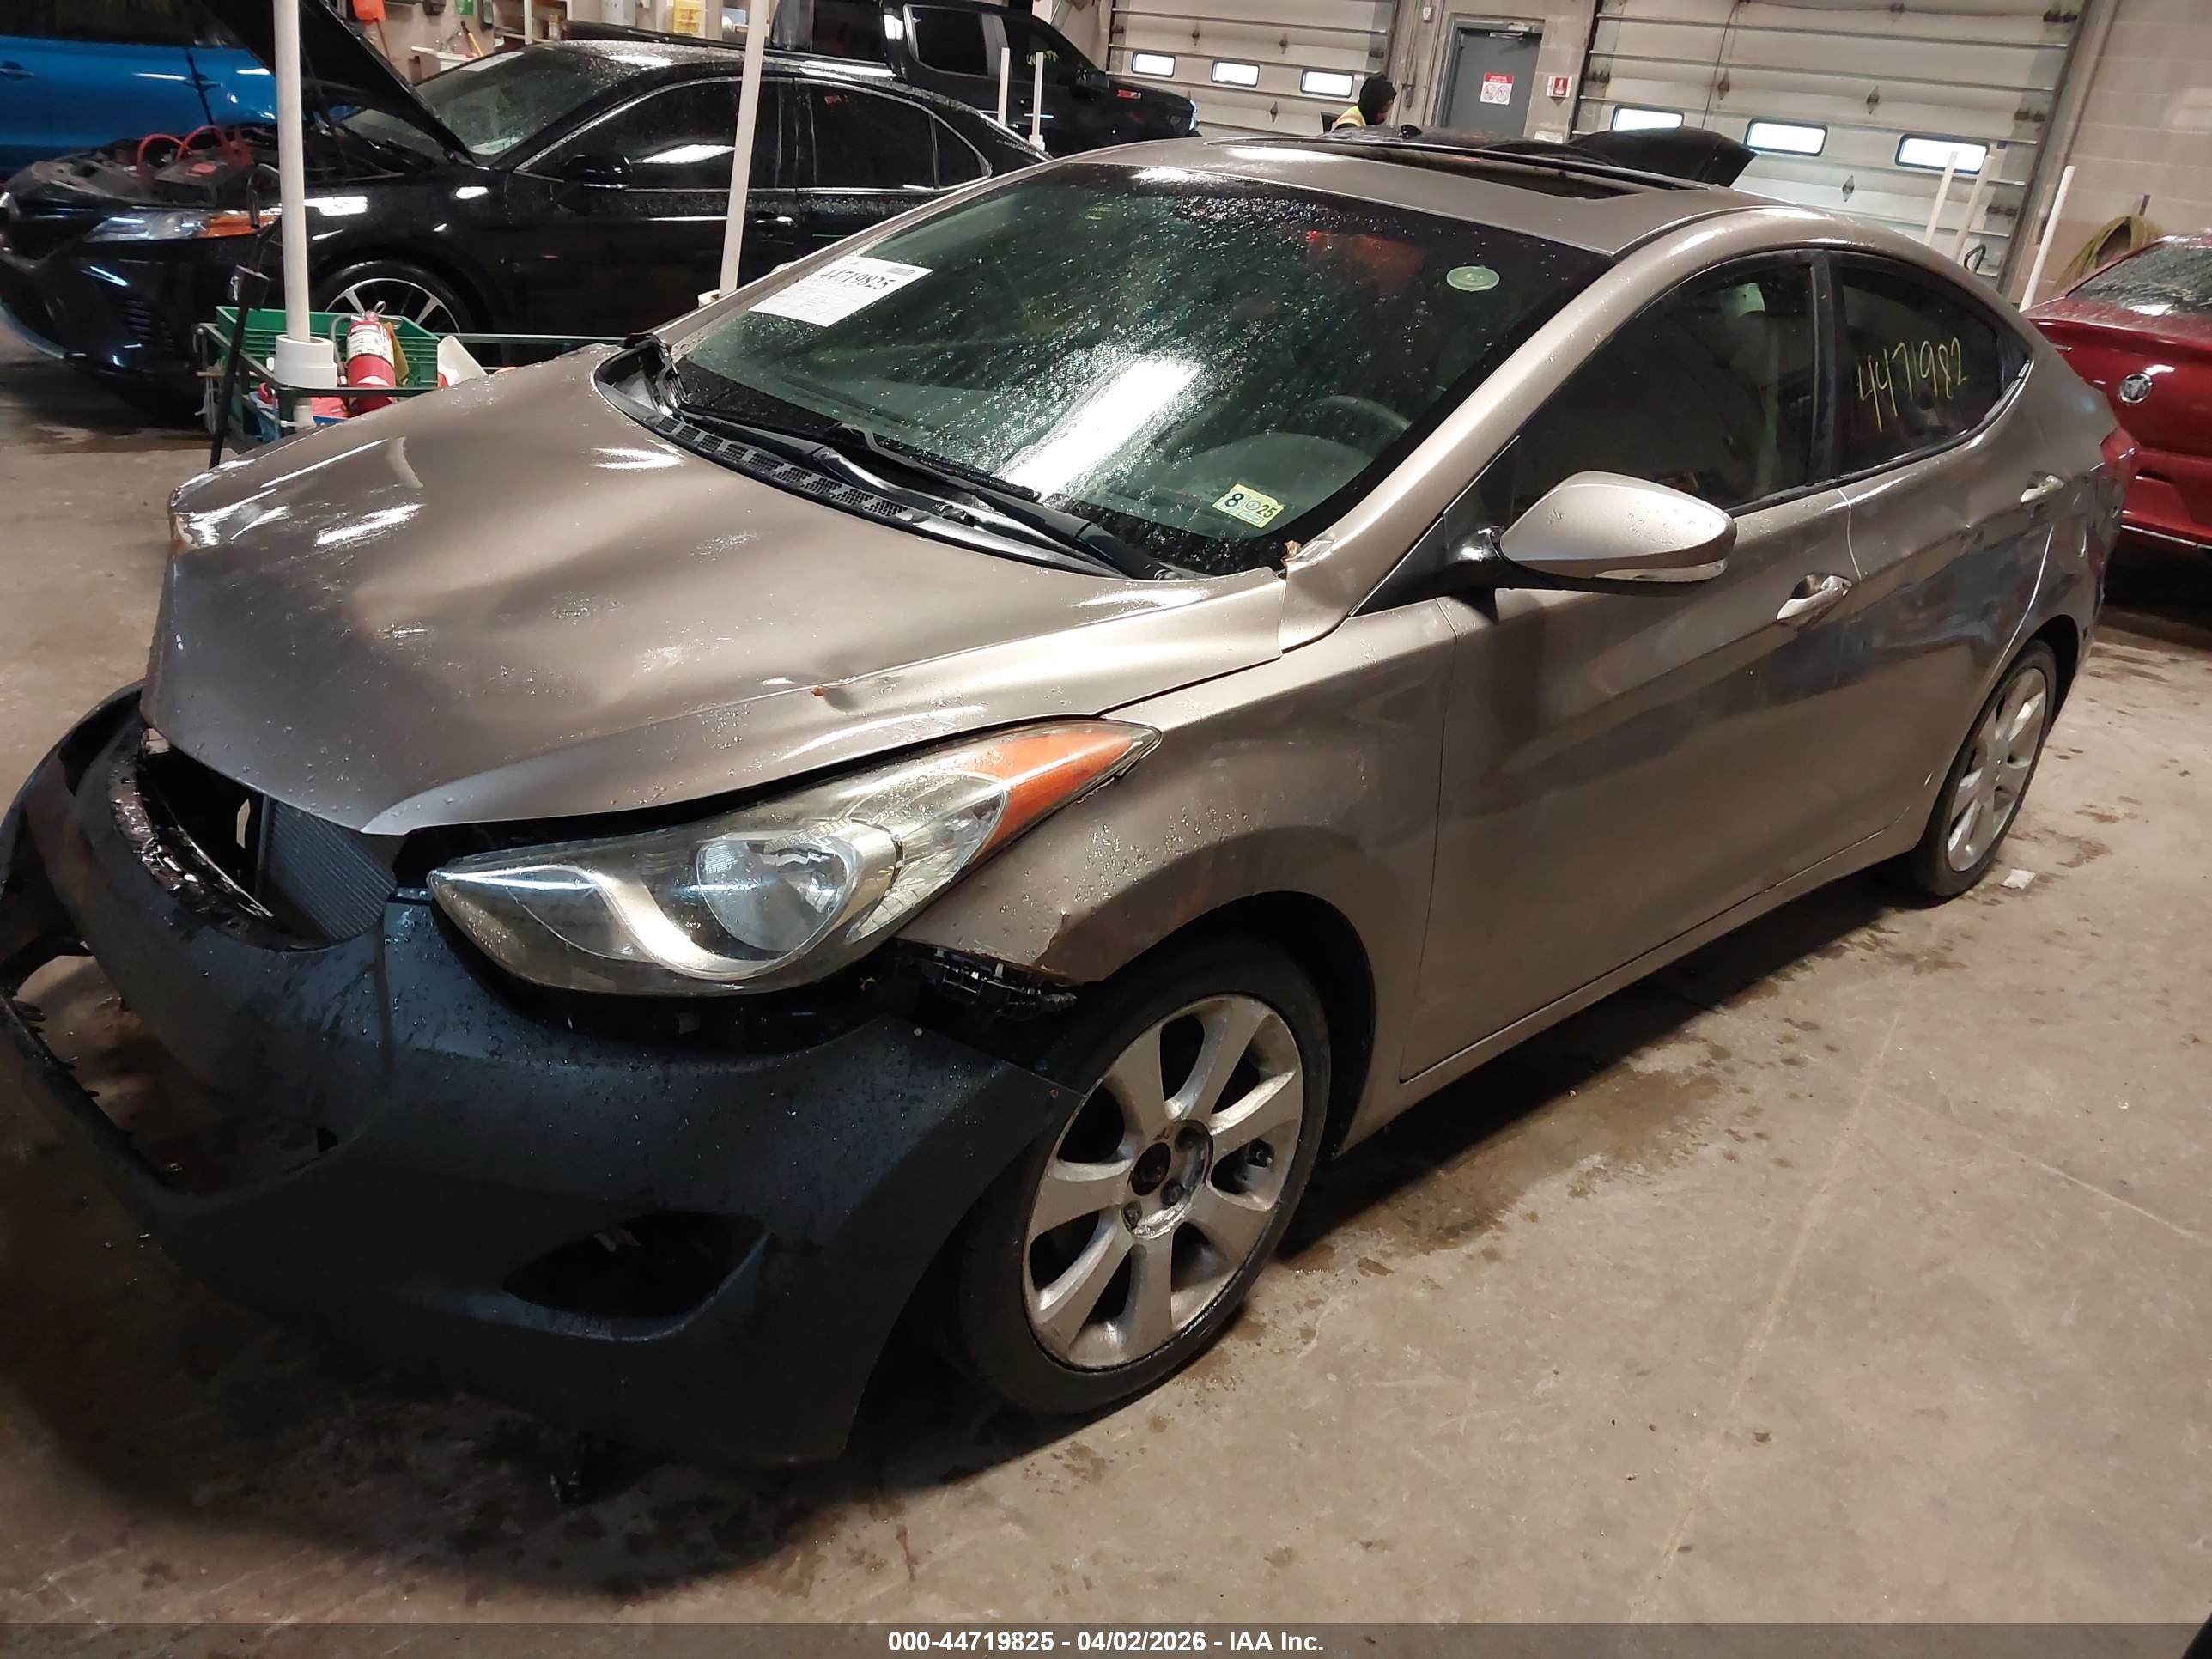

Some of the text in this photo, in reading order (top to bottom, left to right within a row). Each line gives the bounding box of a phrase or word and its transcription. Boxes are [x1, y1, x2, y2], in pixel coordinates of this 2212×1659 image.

[820, 269, 896, 289] 44719825
[1225, 493, 1244, 507] 8
[1255, 504, 1278, 518] 25
